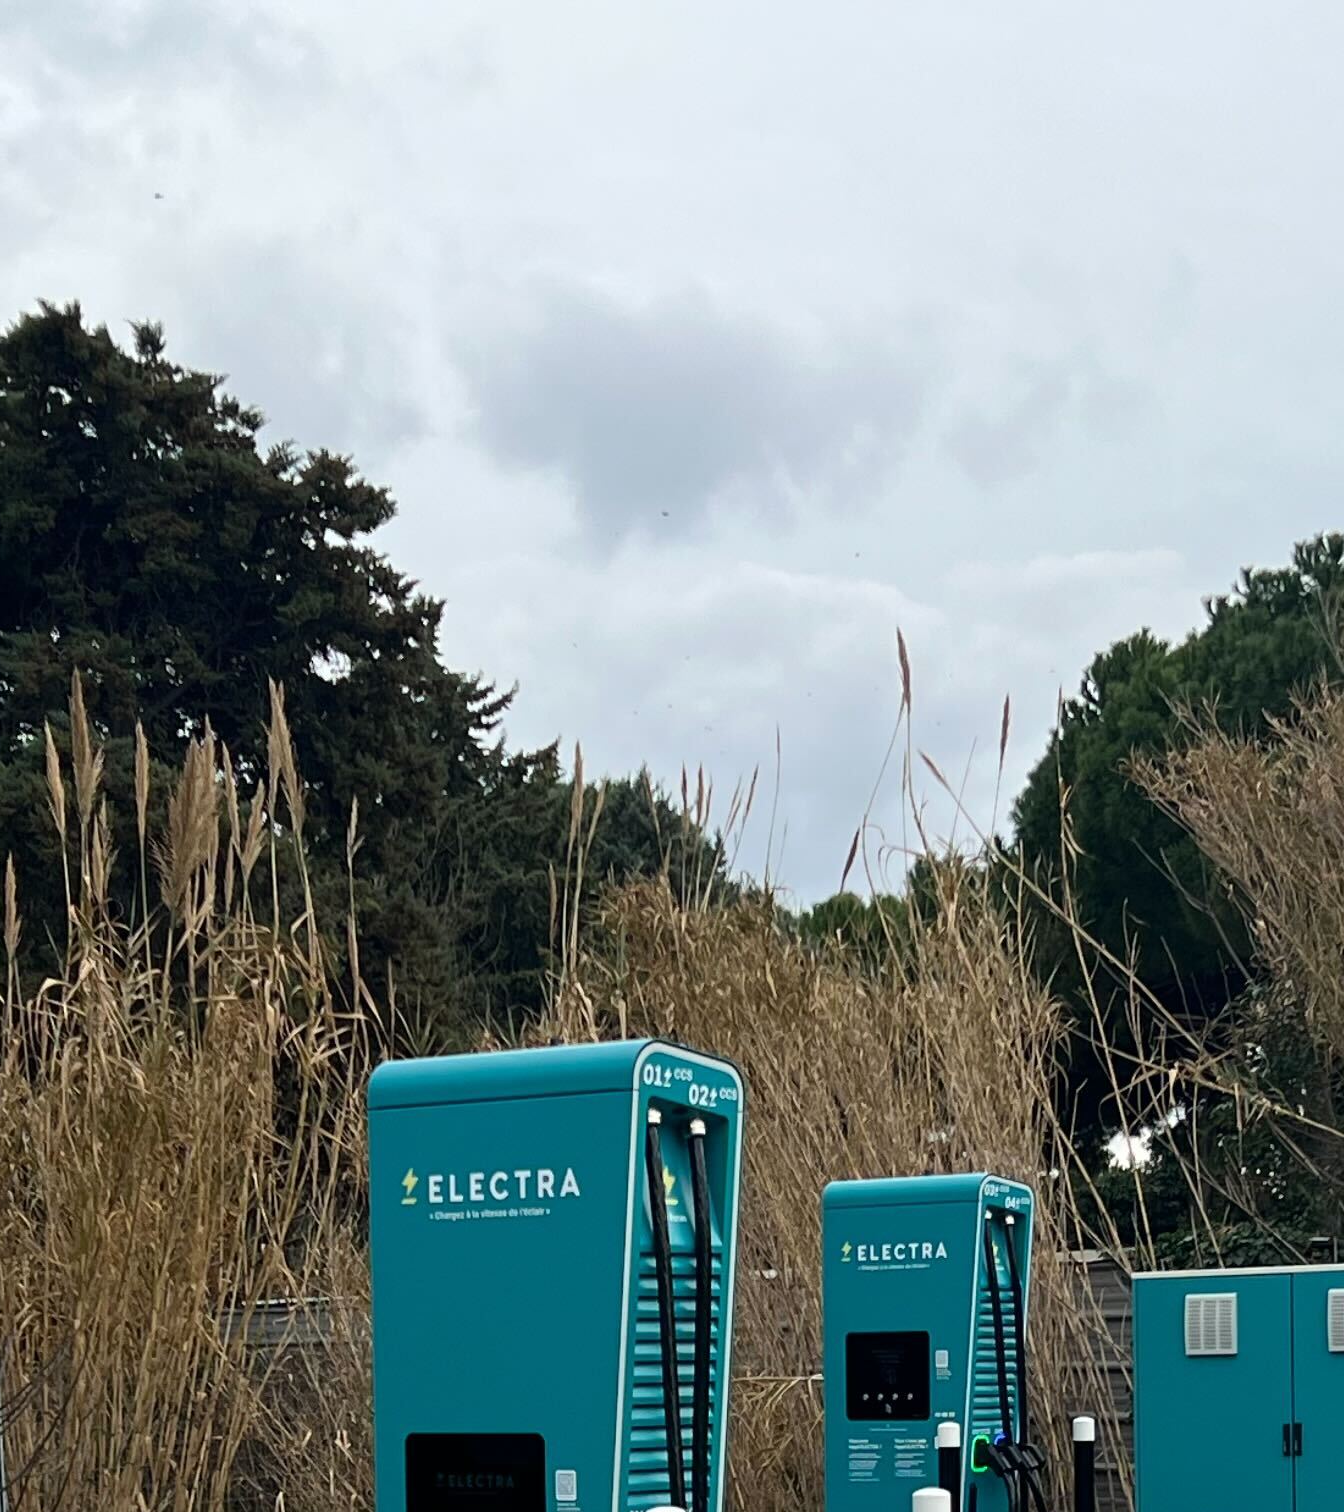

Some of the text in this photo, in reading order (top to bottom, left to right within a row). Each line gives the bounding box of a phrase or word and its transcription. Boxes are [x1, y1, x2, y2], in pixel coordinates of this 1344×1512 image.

[643, 1063, 694, 1086] 01 CCS
[689, 1083, 737, 1107] 02 CCS
[428, 1167, 581, 1204] ELECTRA
[857, 1241, 948, 1261] ELECTRA
[447, 1472, 514, 1488] ELECTRA
